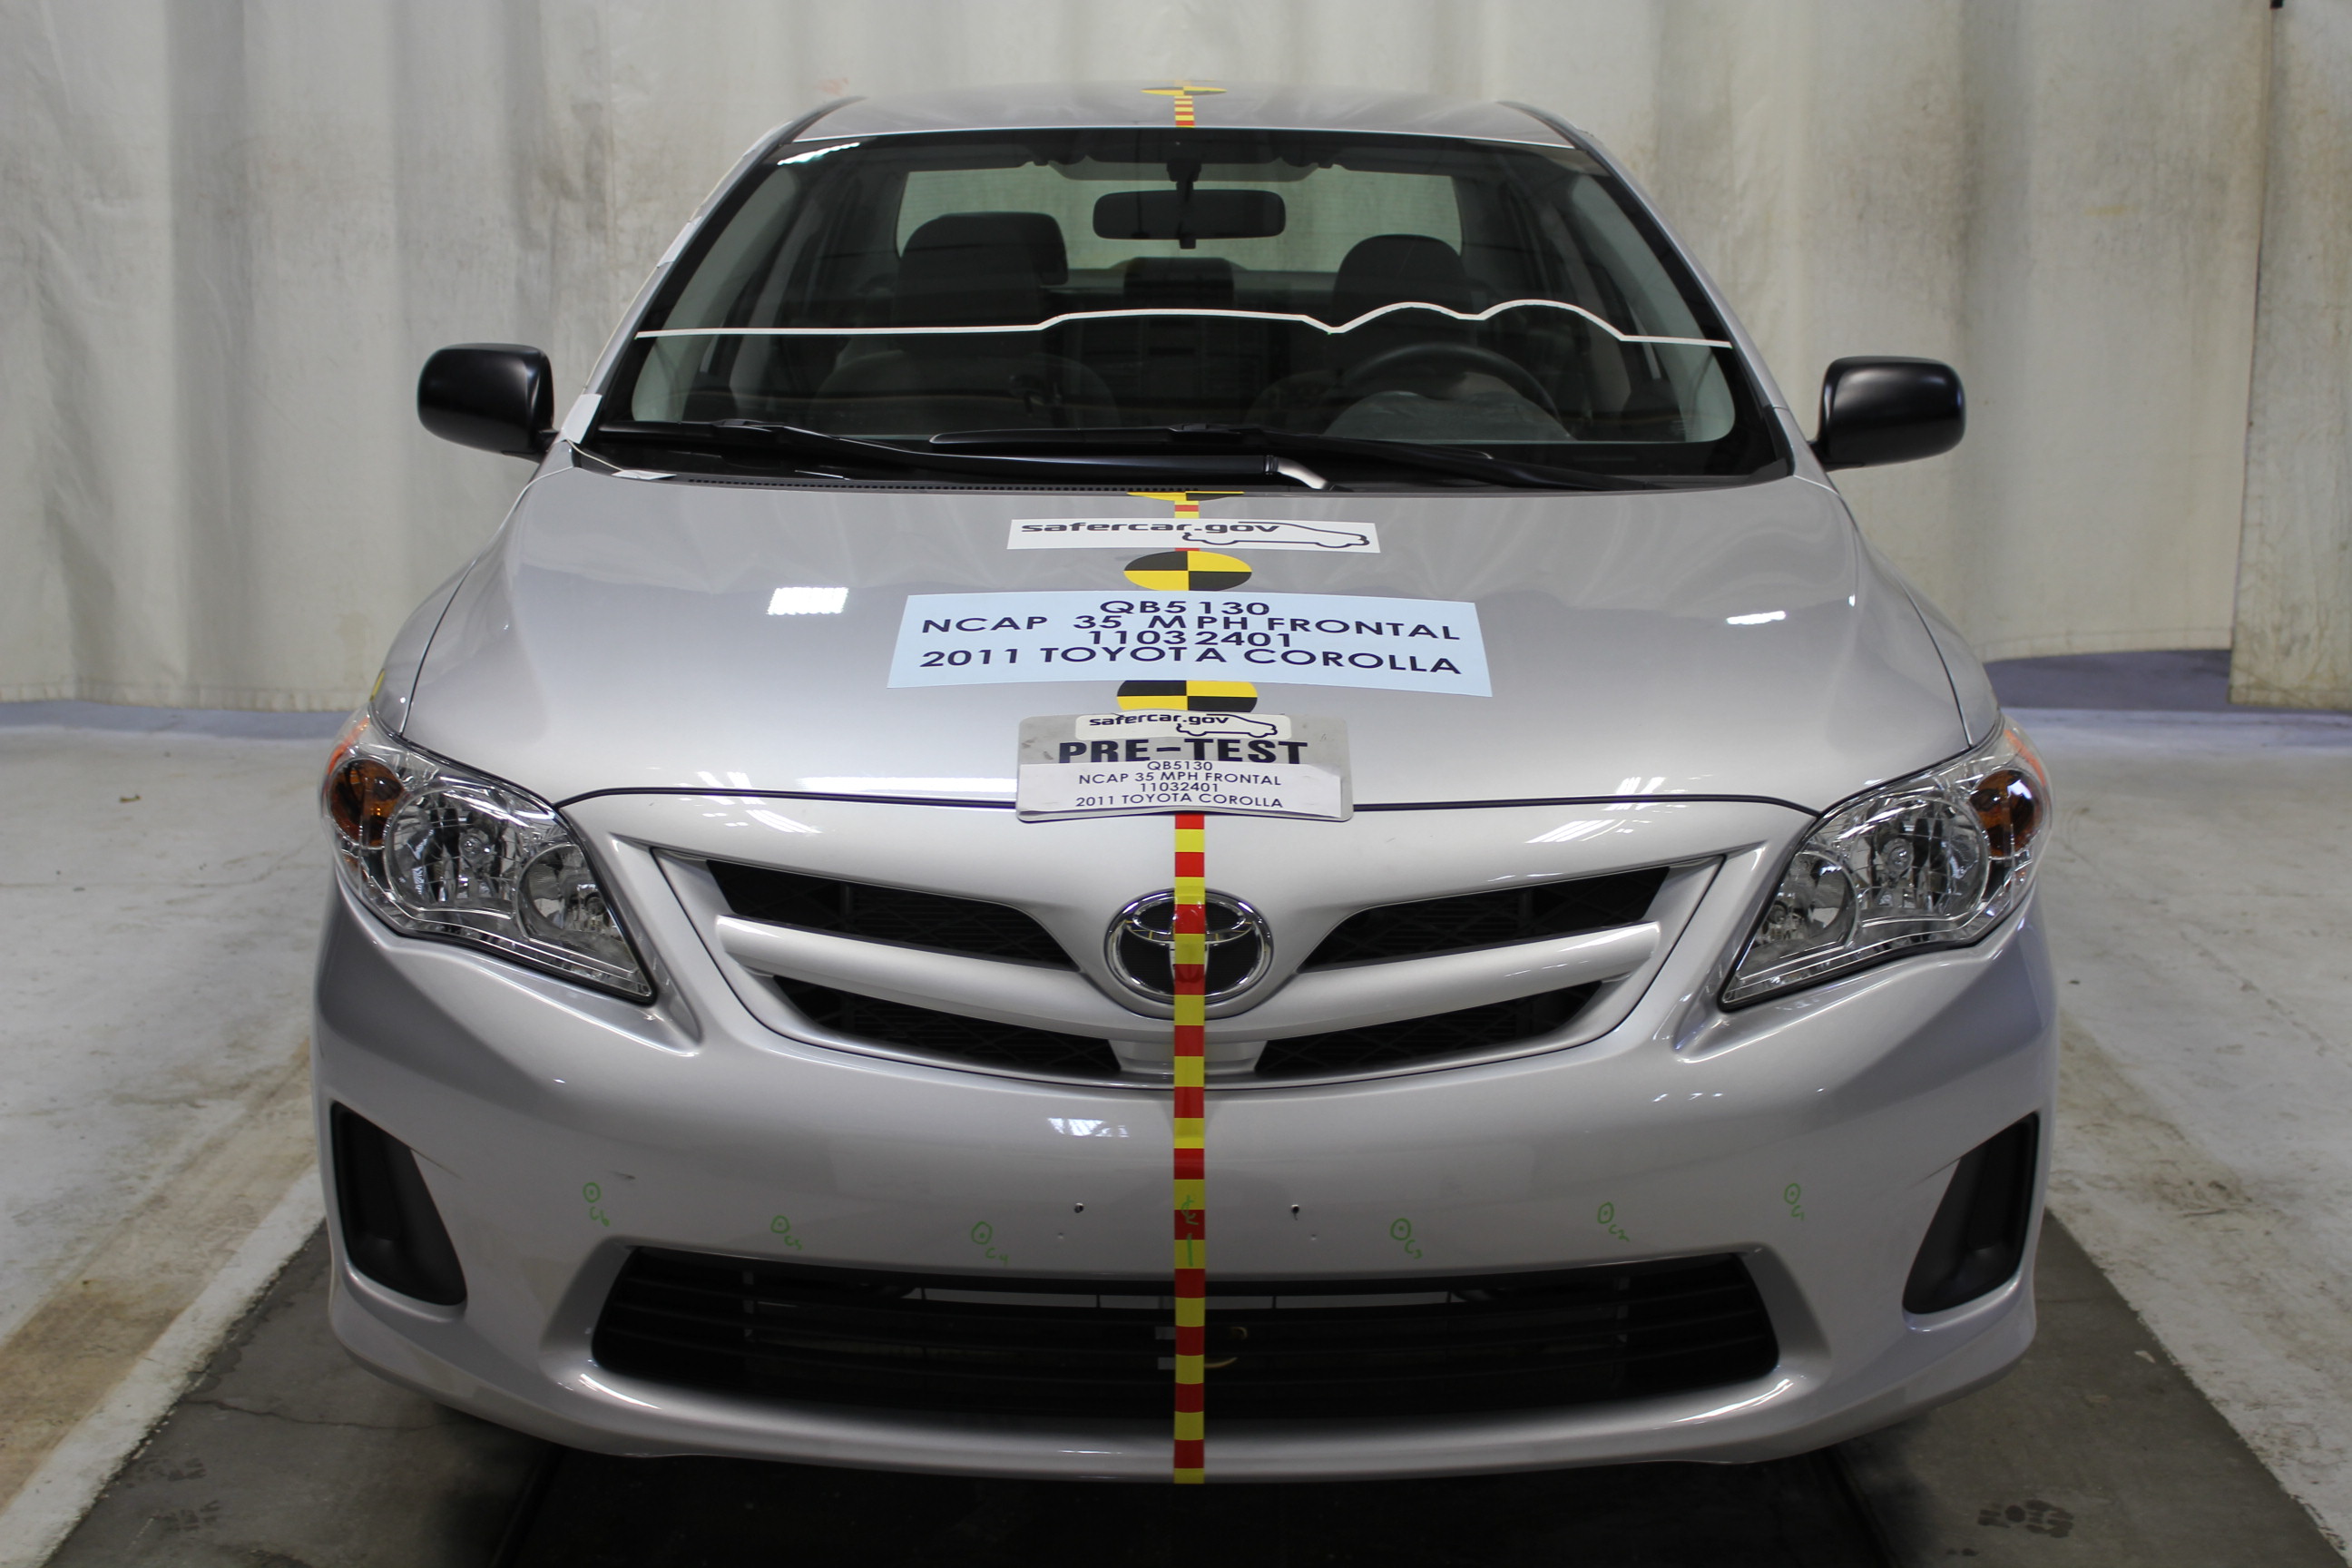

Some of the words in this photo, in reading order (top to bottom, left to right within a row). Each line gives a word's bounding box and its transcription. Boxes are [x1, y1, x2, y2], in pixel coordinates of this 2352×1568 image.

[1021, 521, 1281, 534] safercar.gov
[1099, 600, 1270, 616] QB5130
[921, 615, 1048, 634] NCAP
[1073, 614, 1122, 630] 35
[1147, 614, 1249, 631] MPH
[1267, 617, 1461, 641] FRONTAL
[1088, 630, 1291, 648] 11032401
[919, 648, 1019, 668] 2011
[1039, 645, 1227, 663] TOYOTA
[1243, 648, 1463, 675] COROLLA
[1089, 713, 1230, 726] safercar.gov
[1058, 738, 1308, 765] PRE-TEST
[1146, 760, 1213, 771] QB5130
[1078, 773, 1130, 785] NCAP
[1134, 772, 1155, 782] 35
[1159, 771, 1199, 781] MPH
[1205, 772, 1282, 786] FRONTAL
[1141, 781, 1219, 793] 11032401
[1075, 795, 1114, 808] 2011
[1121, 792, 1193, 805] TOYOTA
[1198, 793, 1284, 808] COROLLA
